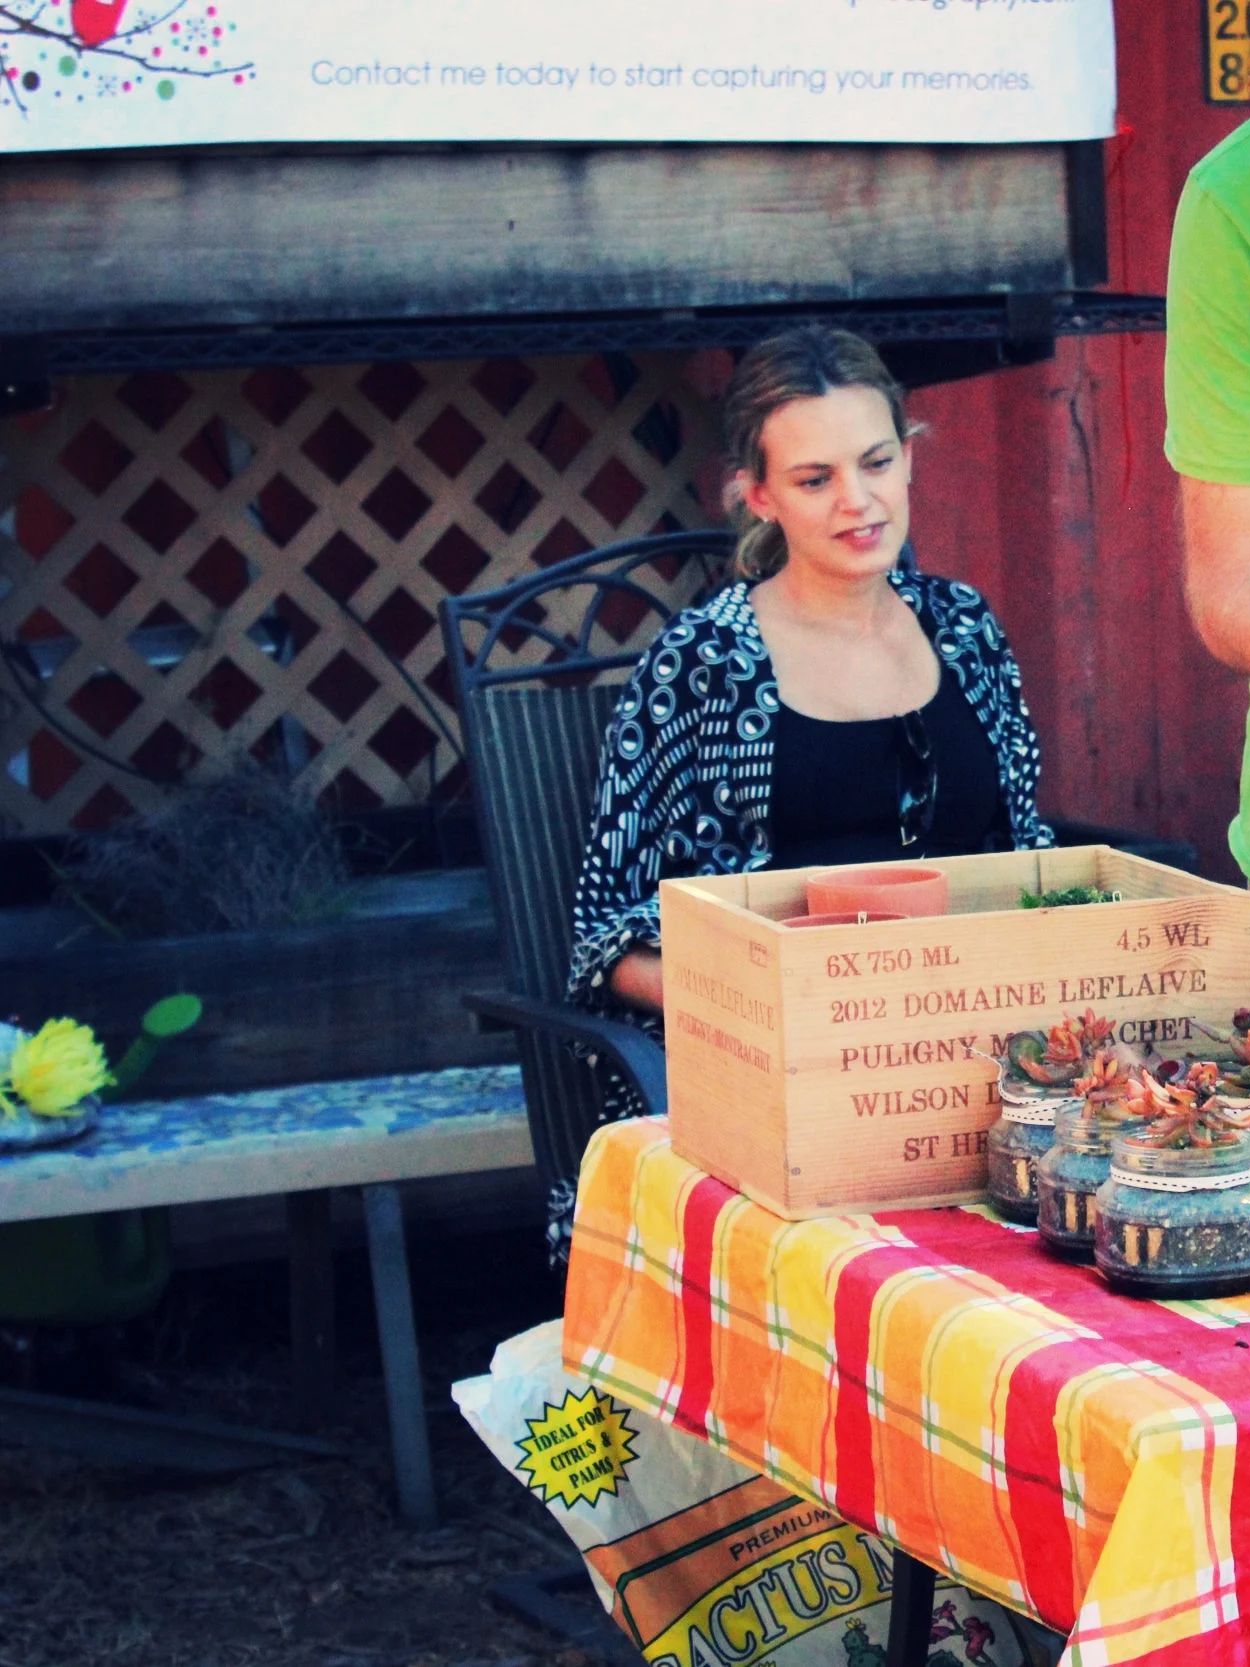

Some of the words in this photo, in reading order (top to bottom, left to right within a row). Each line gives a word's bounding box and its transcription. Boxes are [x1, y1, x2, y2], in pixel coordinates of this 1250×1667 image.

[311, 60, 431, 86] Contact
[441, 66, 486, 86] me
[496, 61, 579, 91] today
[590, 62, 617, 87] to
[624, 63, 683, 87] start
[692, 64, 827, 94] capturing
[836, 68, 894, 94] your
[902, 67, 1035, 92] memories.
[1163, 921, 1210, 949] WL
[826, 951, 862, 978] 6X
[867, 948, 912, 975] 750
[922, 944, 960, 968] ML
[830, 998, 888, 1024] 2012
[904, 980, 1046, 1018] DOMAINE
[1058, 968, 1208, 1003] LEFLAIVE
[840, 1035, 977, 1072] PULIGNY
[850, 1084, 971, 1118] WILSON
[902, 1135, 940, 1162] ST
[534, 1423, 577, 1453] IDEAL
[576, 1406, 605, 1431] FOR
[550, 1438, 597, 1472] CITRUS
[600, 1431, 612, 1448] &
[568, 1455, 614, 1489] PALMS
[728, 1508, 833, 1562] PREMIUM
[650, 1540, 862, 1667] ACTUS
